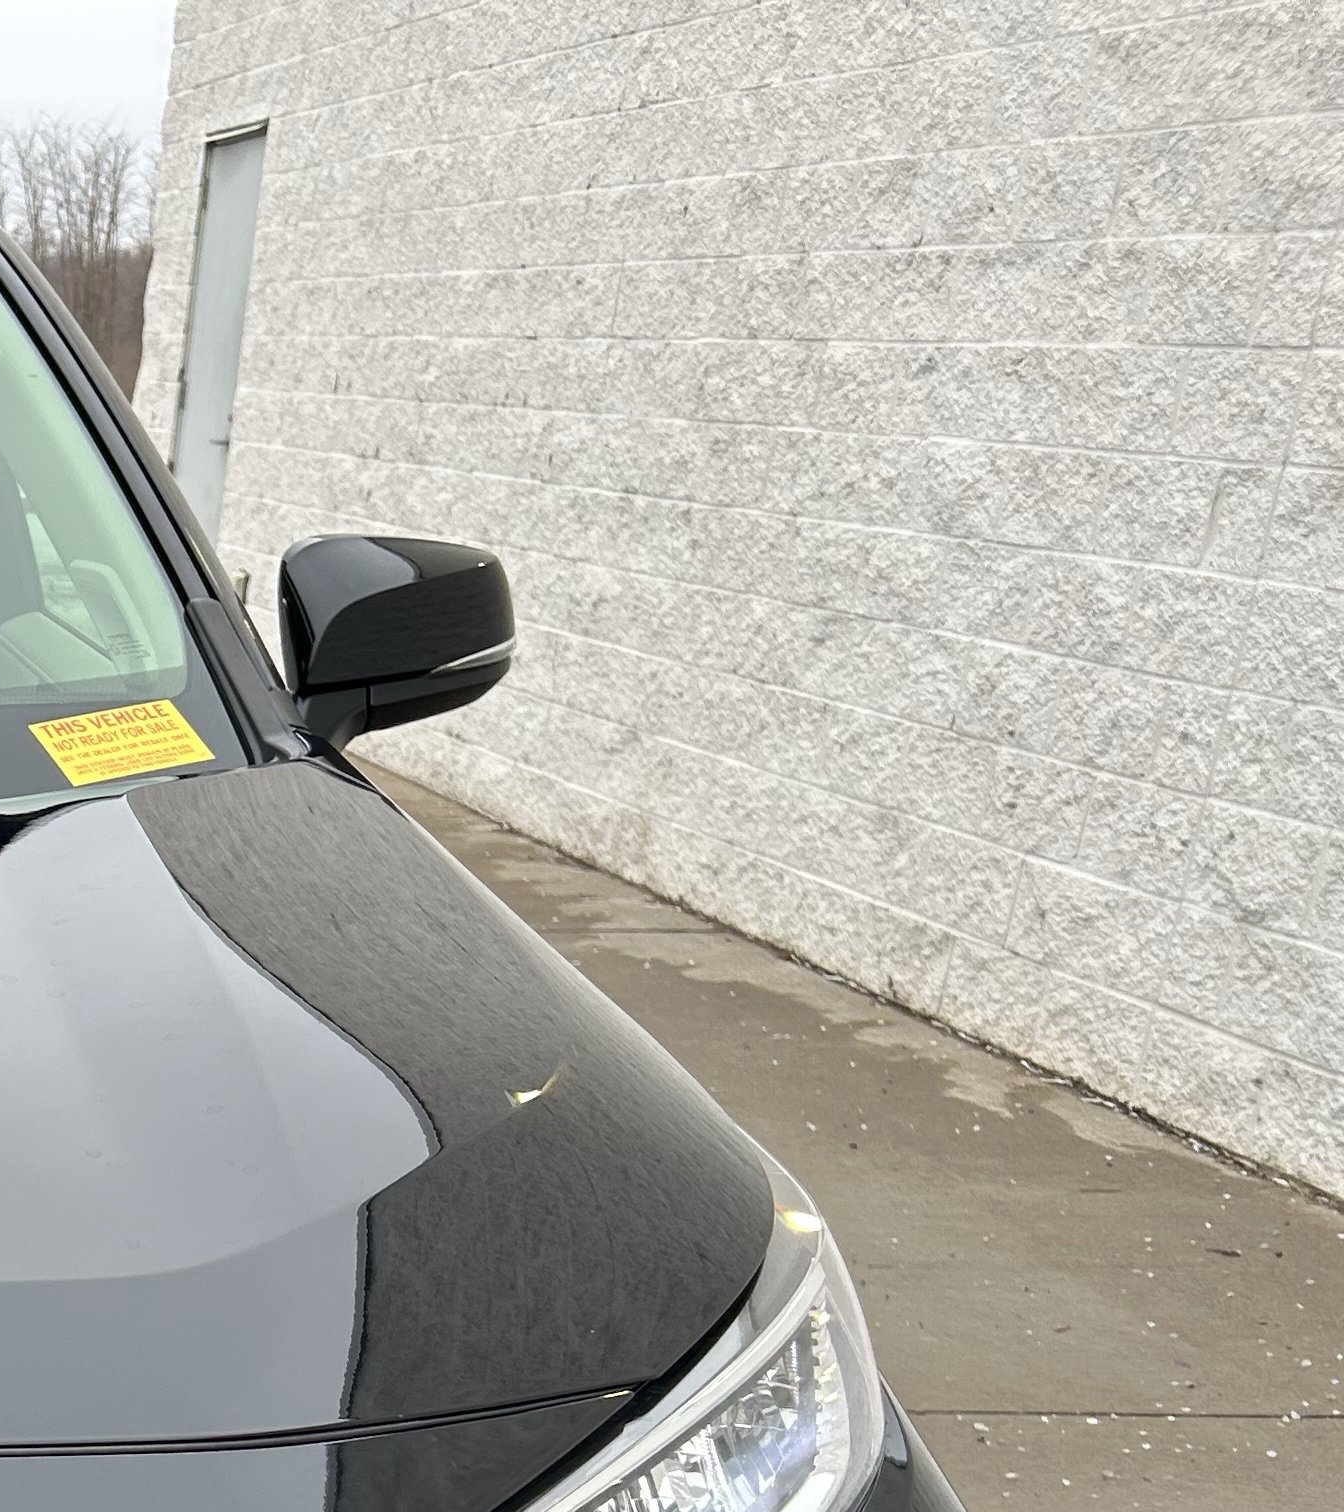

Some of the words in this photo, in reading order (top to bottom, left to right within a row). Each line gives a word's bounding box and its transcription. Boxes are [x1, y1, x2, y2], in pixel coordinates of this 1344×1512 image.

[38, 718, 88, 739] THIS
[86, 703, 171, 730] VEHICLE
[52, 738, 79, 753] NOT
[78, 730, 120, 748] READY
[120, 725, 147, 739] FOR
[146, 719, 180, 735] SALE
